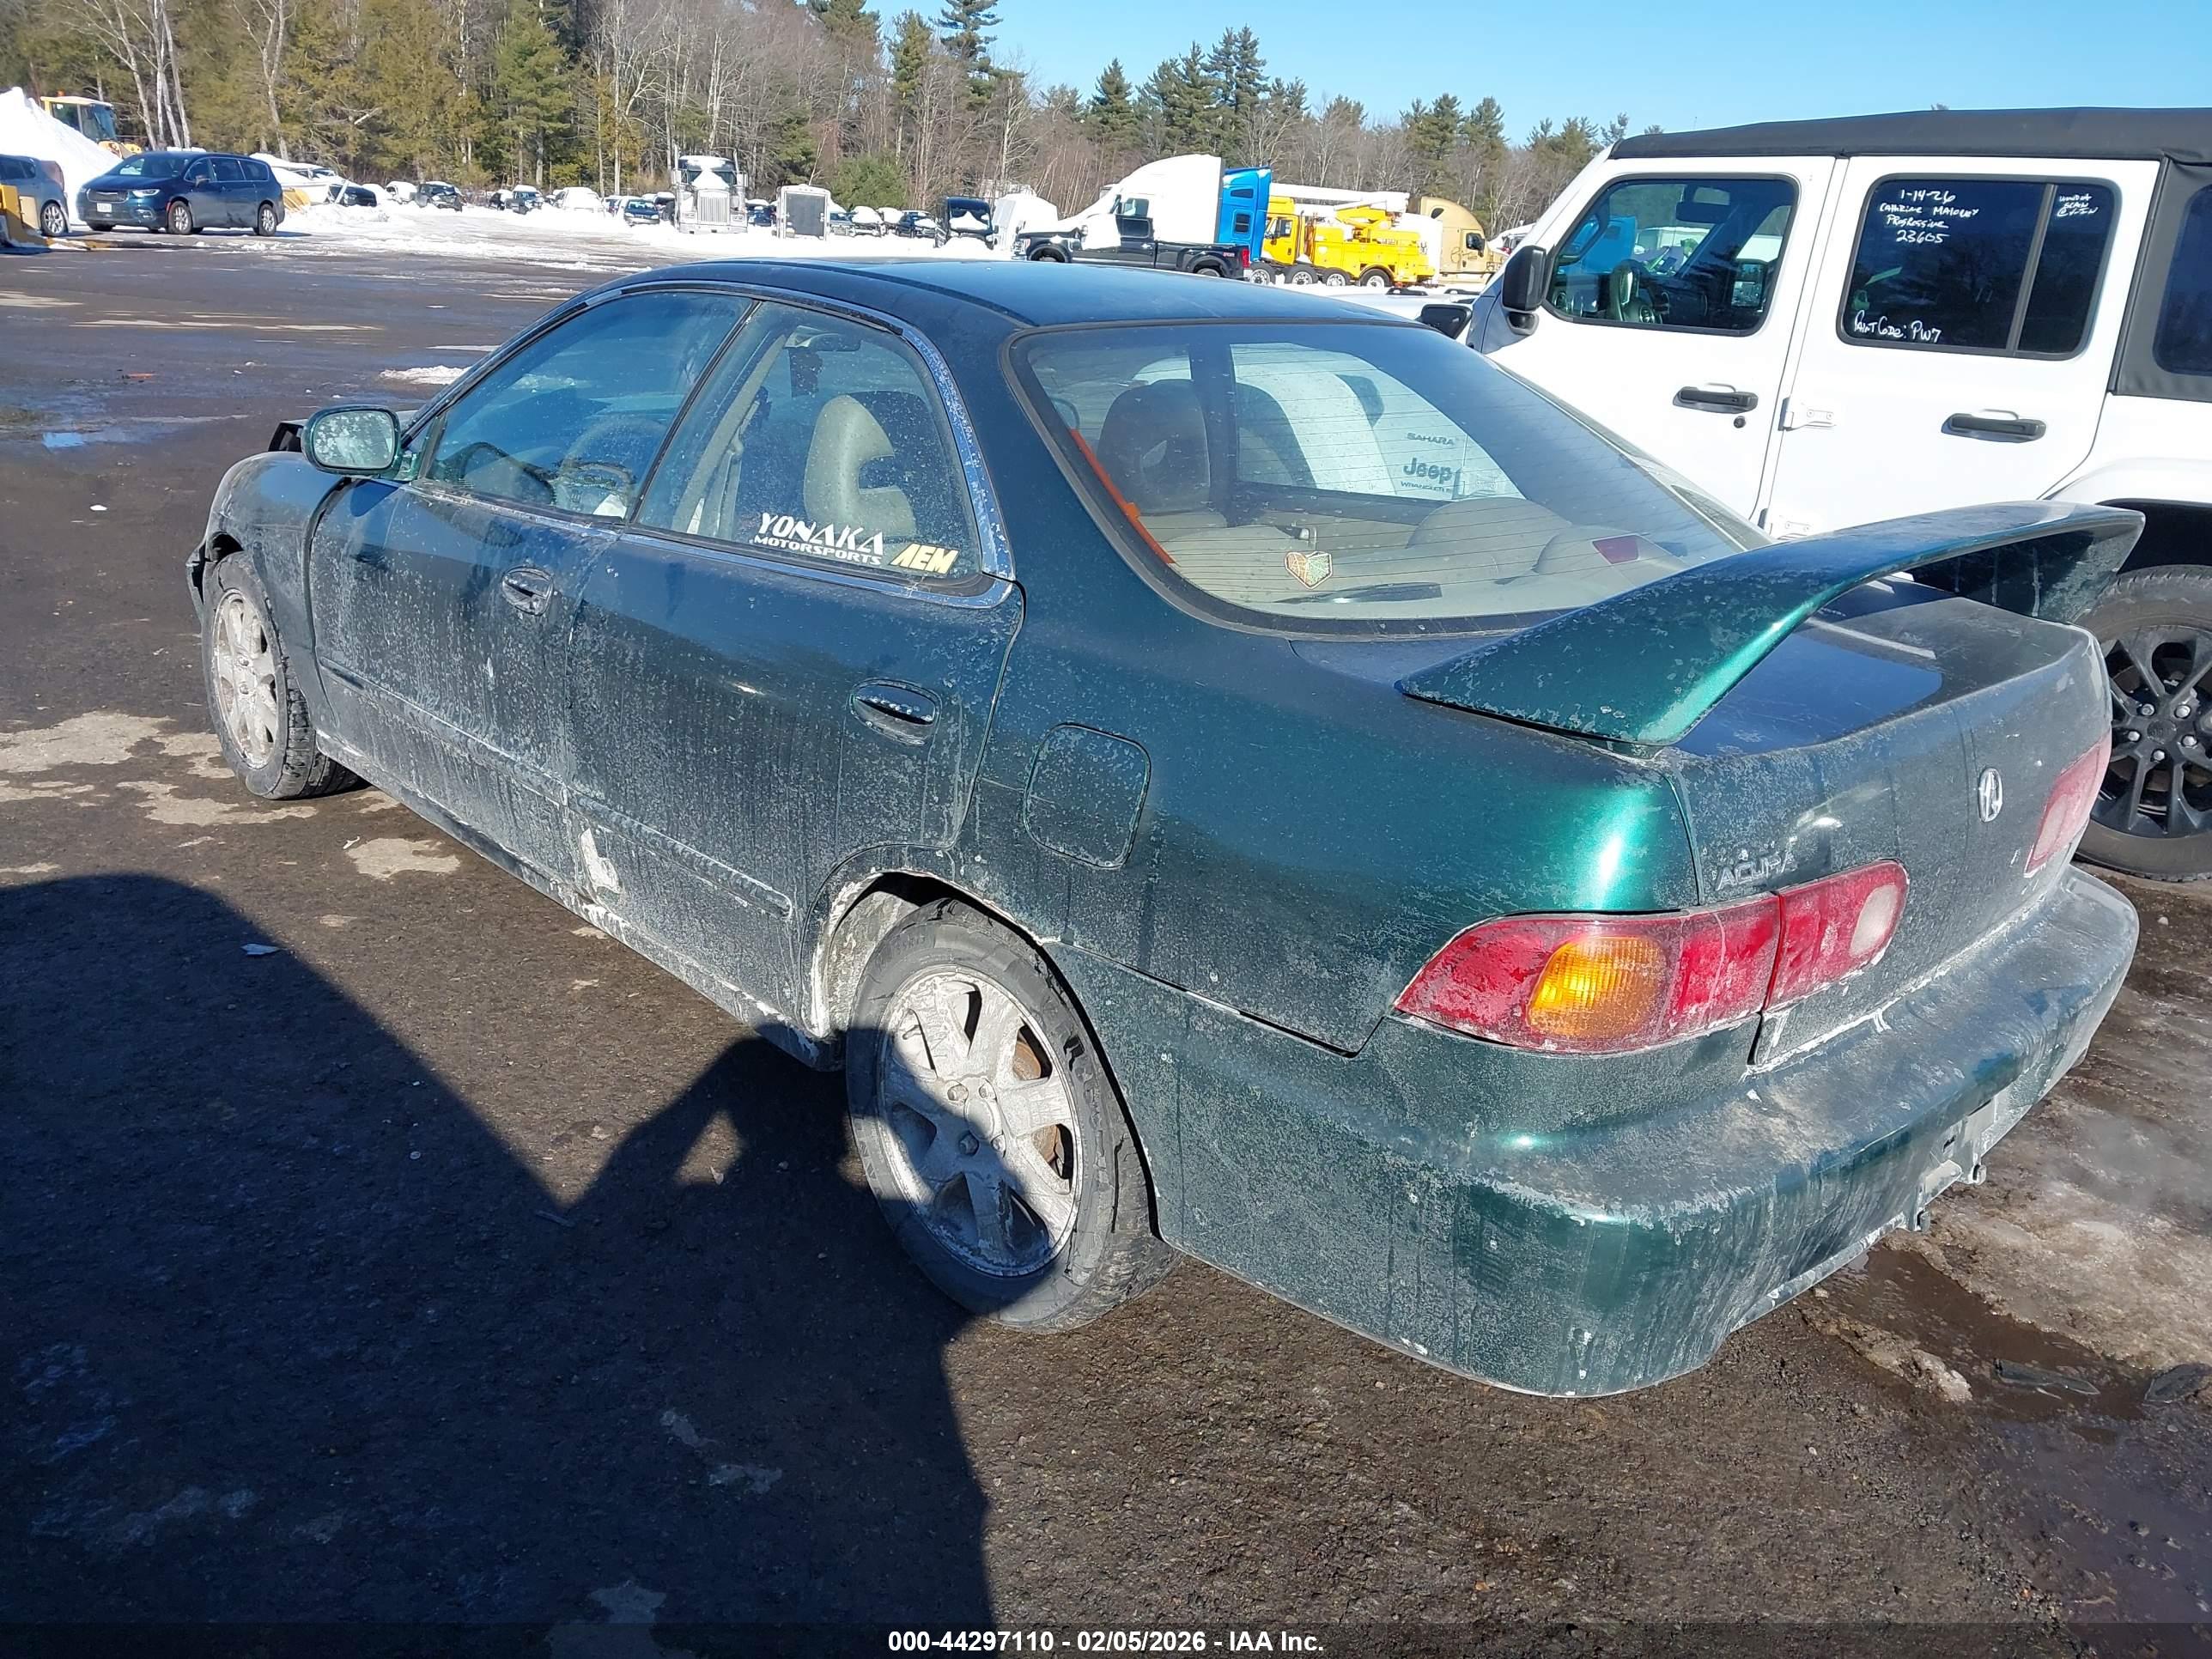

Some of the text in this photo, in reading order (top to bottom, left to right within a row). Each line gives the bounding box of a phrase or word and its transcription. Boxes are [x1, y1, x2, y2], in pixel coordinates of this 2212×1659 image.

[1900, 189, 1956, 204] 1-14-26
[1896, 229, 1950, 243] 23605
[1911, 320, 1942, 343] PW7
[1407, 432, 1455, 446] SAHARA
[1403, 458, 1453, 484] Jeep
[758, 513, 884, 556] YONAKA
[754, 535, 883, 565] MOTORSPORTS
[890, 543, 960, 574] AEM
